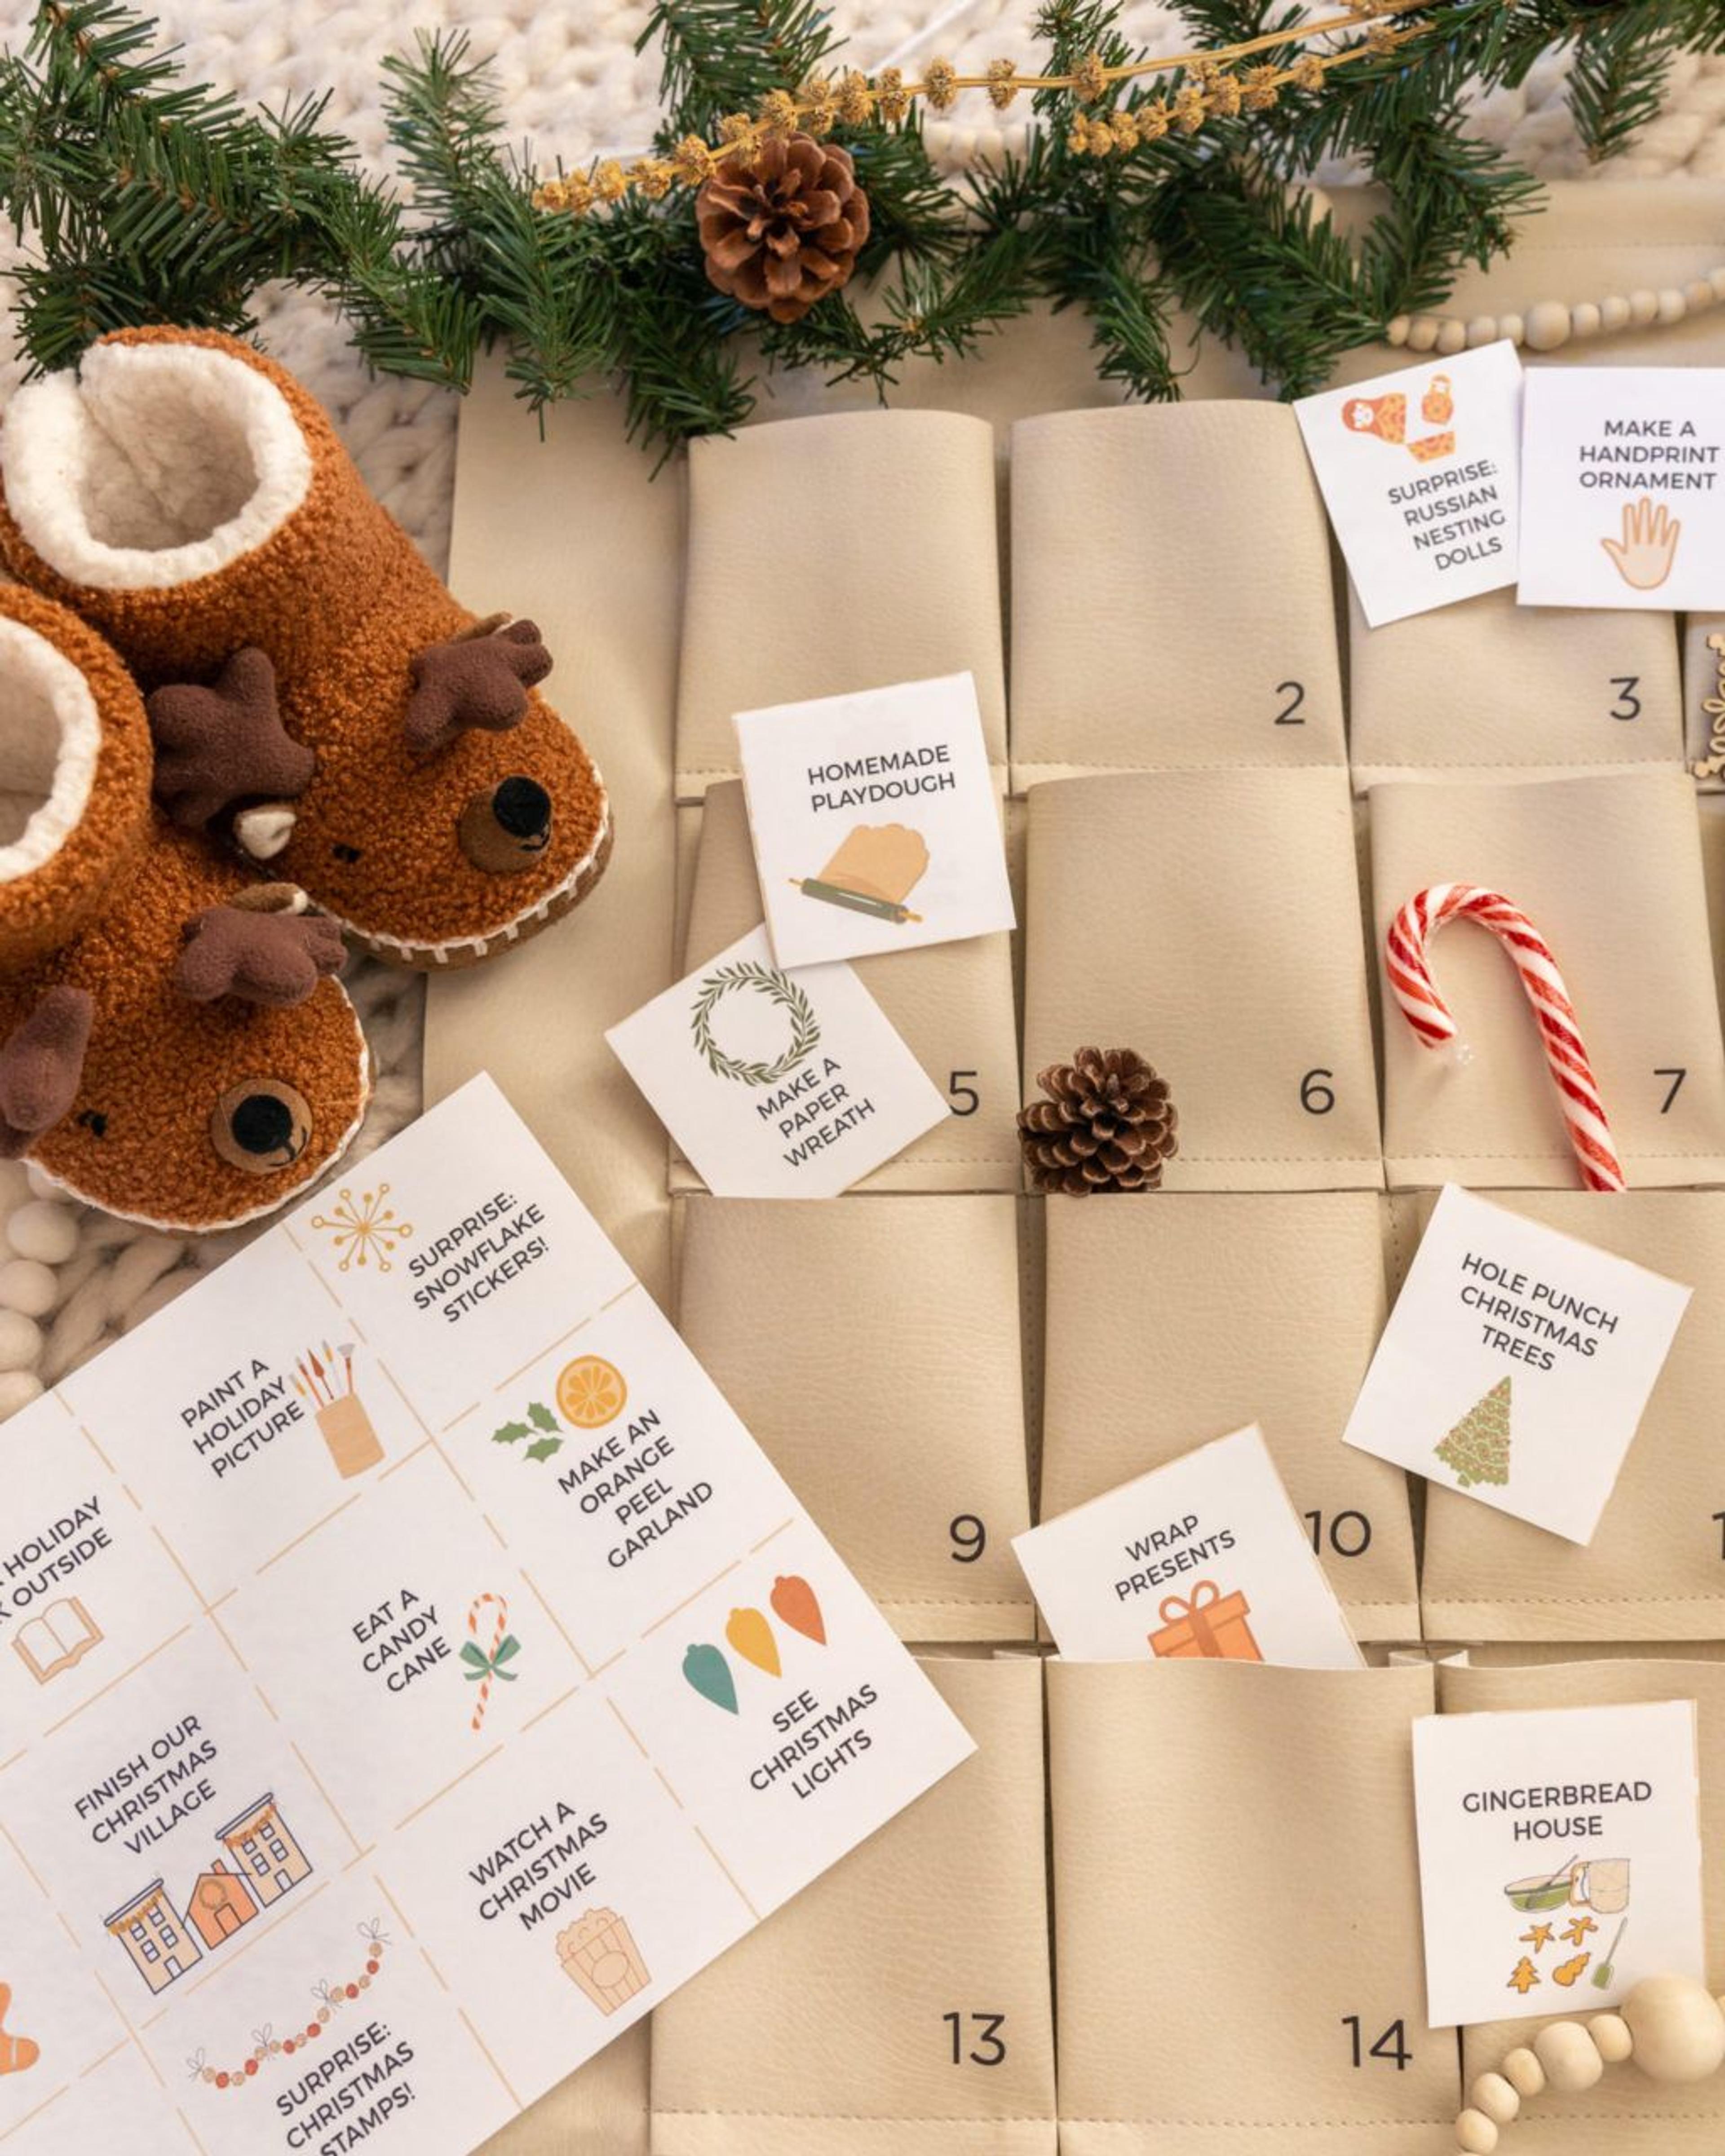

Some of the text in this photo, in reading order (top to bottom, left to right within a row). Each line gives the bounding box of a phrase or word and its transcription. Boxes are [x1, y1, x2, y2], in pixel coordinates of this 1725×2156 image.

[1580, 446, 1720, 463] HANDPRINT
[1605, 420, 1696, 437] MAKE A
[1388, 459, 1499, 504] SURPRISE:
[1404, 486, 1497, 526] RUSSIAN
[1579, 472, 1716, 489] ORNAMENT
[1413, 510, 1505, 549] NESTING
[1435, 537, 1502, 570] DOLLS
[1274, 681, 1305, 725] 2
[1610, 676, 1641, 720] 3
[808, 744, 950, 785] HOMEMADE
[811, 772, 955, 812] PLAYDOUGH
[756, 1058, 841, 1120] MAKE A
[778, 1084, 849, 1139] PAPER
[950, 1071, 979, 1116] 5
[1300, 1069, 1335, 1115] 6
[1654, 1069, 1686, 1114] 7
[783, 1098, 875, 1166] WREATH
[409, 1193, 518, 1277] SURPRISE:
[414, 1203, 545, 1309] SNOWFLAKE
[443, 1236, 548, 1323] STICKERS!
[1461, 1253, 1619, 1334] HOLE PUNCH
[1461, 1286, 1598, 1356] CHRISTMAS
[1482, 1324, 1555, 1370] TREES
[181, 1359, 270, 1428] PAINT A
[193, 1376, 285, 1455] HOLIDAY
[211, 1401, 305, 1478] PICTURE
[557, 1409, 661, 1494] MAKE AN
[580, 1435, 675, 1514] ORANGE
[615, 1479, 673, 1525] PEEL
[3, 1495, 100, 1578] HOLIDAY
[608, 1482, 712, 1568] GARLAND
[950, 1515, 986, 1563] 9
[1125, 1515, 1199, 1561] WRAP
[1305, 1510, 1371, 1557] 10
[12, 1527, 112, 1606] OUTSIDE
[1115, 1529, 1235, 1601] PRESENTS
[352, 1589, 419, 1644] EAT A
[363, 1605, 438, 1672] CANDY
[387, 1636, 451, 1692] CANE
[750, 1684, 877, 1790] CHRISTMAS
[772, 1690, 819, 1732] SEE
[74, 1715, 201, 1820] FINISH OUR
[92, 1740, 217, 1843] CHRISTMAS
[792, 1729, 872, 1799] LIGHTS
[124, 1778, 216, 1854] VILLAGE
[1463, 1781, 1652, 1813] GINGERBREAD
[469, 1802, 576, 1886] WATCH A
[1514, 1815, 1603, 1841] HOUSE
[479, 1813, 607, 1920] CHRISTMAS
[519, 1862, 596, 1931] MOVIE
[943, 2012, 1006, 2066] 13
[1342, 2016, 1413, 2071] 14
[276, 2022, 391, 2116] SURPRISE:
[287, 2041, 414, 2148] CHRISTMAS
